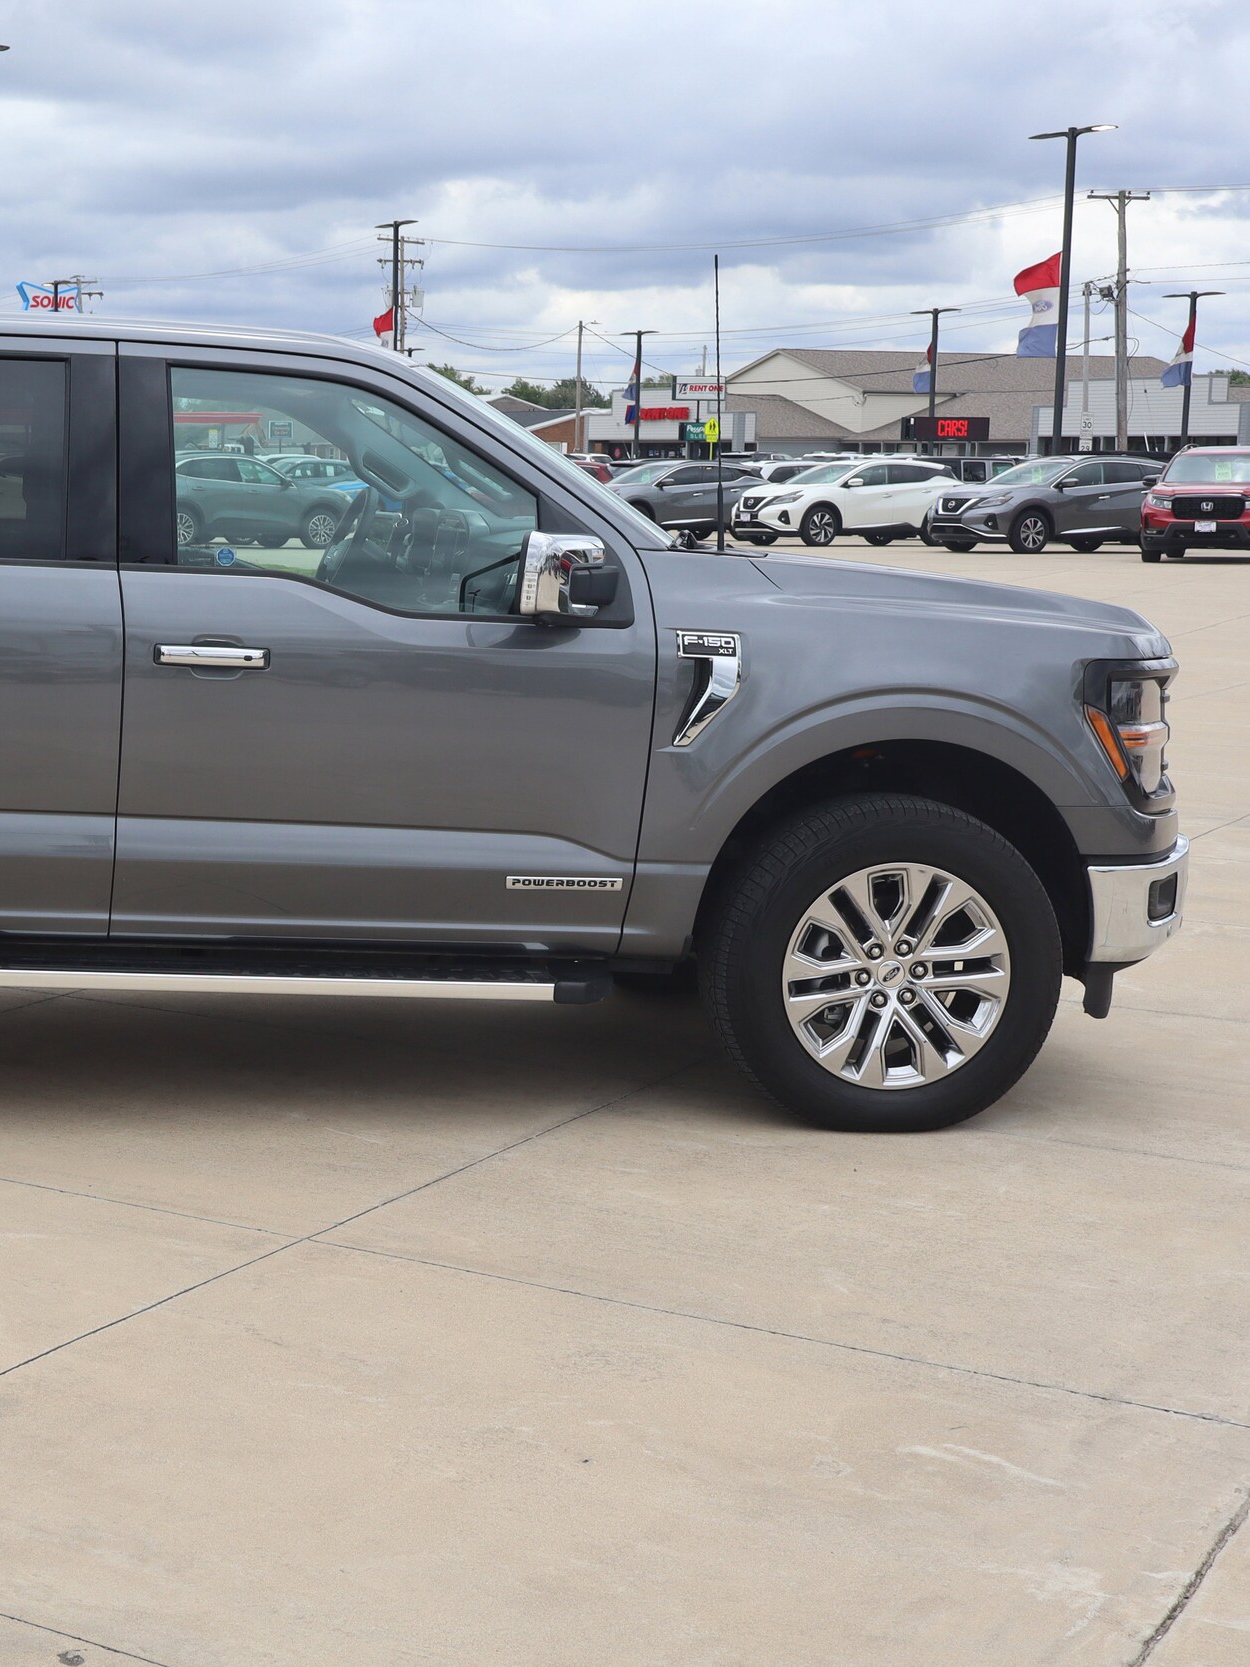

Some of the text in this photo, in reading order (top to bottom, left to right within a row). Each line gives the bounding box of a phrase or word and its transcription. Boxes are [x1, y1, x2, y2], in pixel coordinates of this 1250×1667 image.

[30, 295, 75, 309] SONIC
[640, 407, 689, 420] RENT ONE
[937, 420, 968, 436] CARS!
[683, 635, 734, 647] F-150
[512, 879, 617, 888] POWERBOOST
